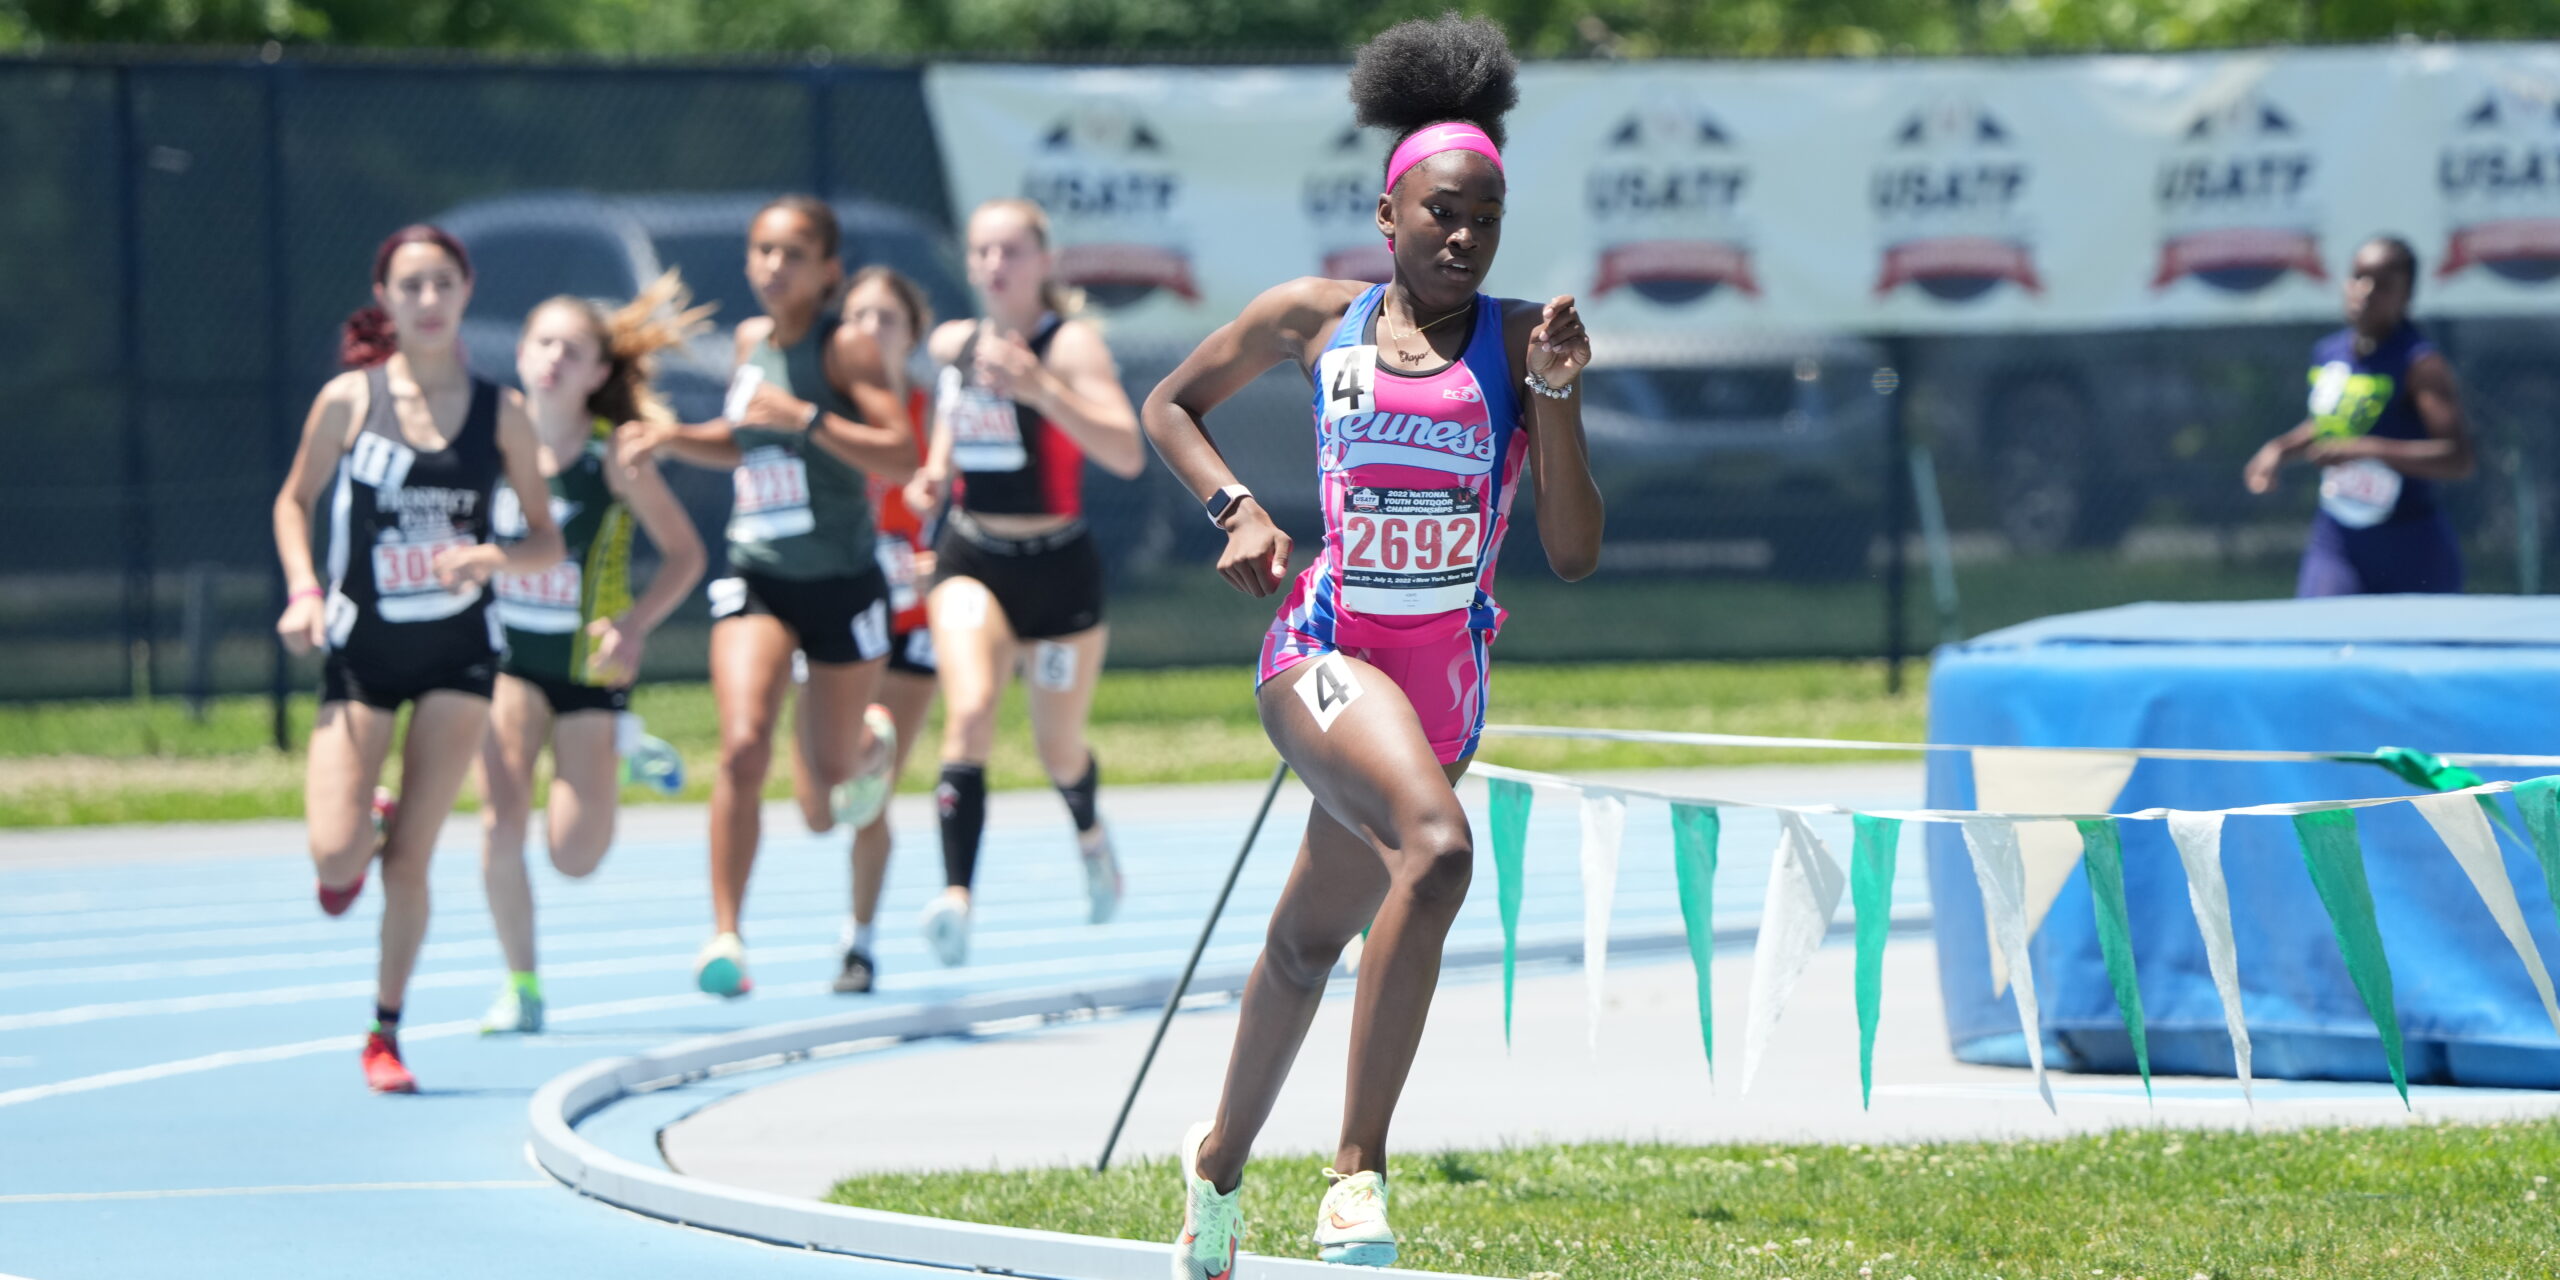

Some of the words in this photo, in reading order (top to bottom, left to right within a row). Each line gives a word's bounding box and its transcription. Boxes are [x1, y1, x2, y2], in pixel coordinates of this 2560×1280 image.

[1332, 350, 1365, 410] 4
[1443, 388, 1470, 400] PCS
[1385, 505, 1454, 513] CHAMPIONSHIPS
[1347, 516, 1476, 570] 2692
[1373, 576, 1386, 584] July
[1316, 662, 1350, 713] 4
